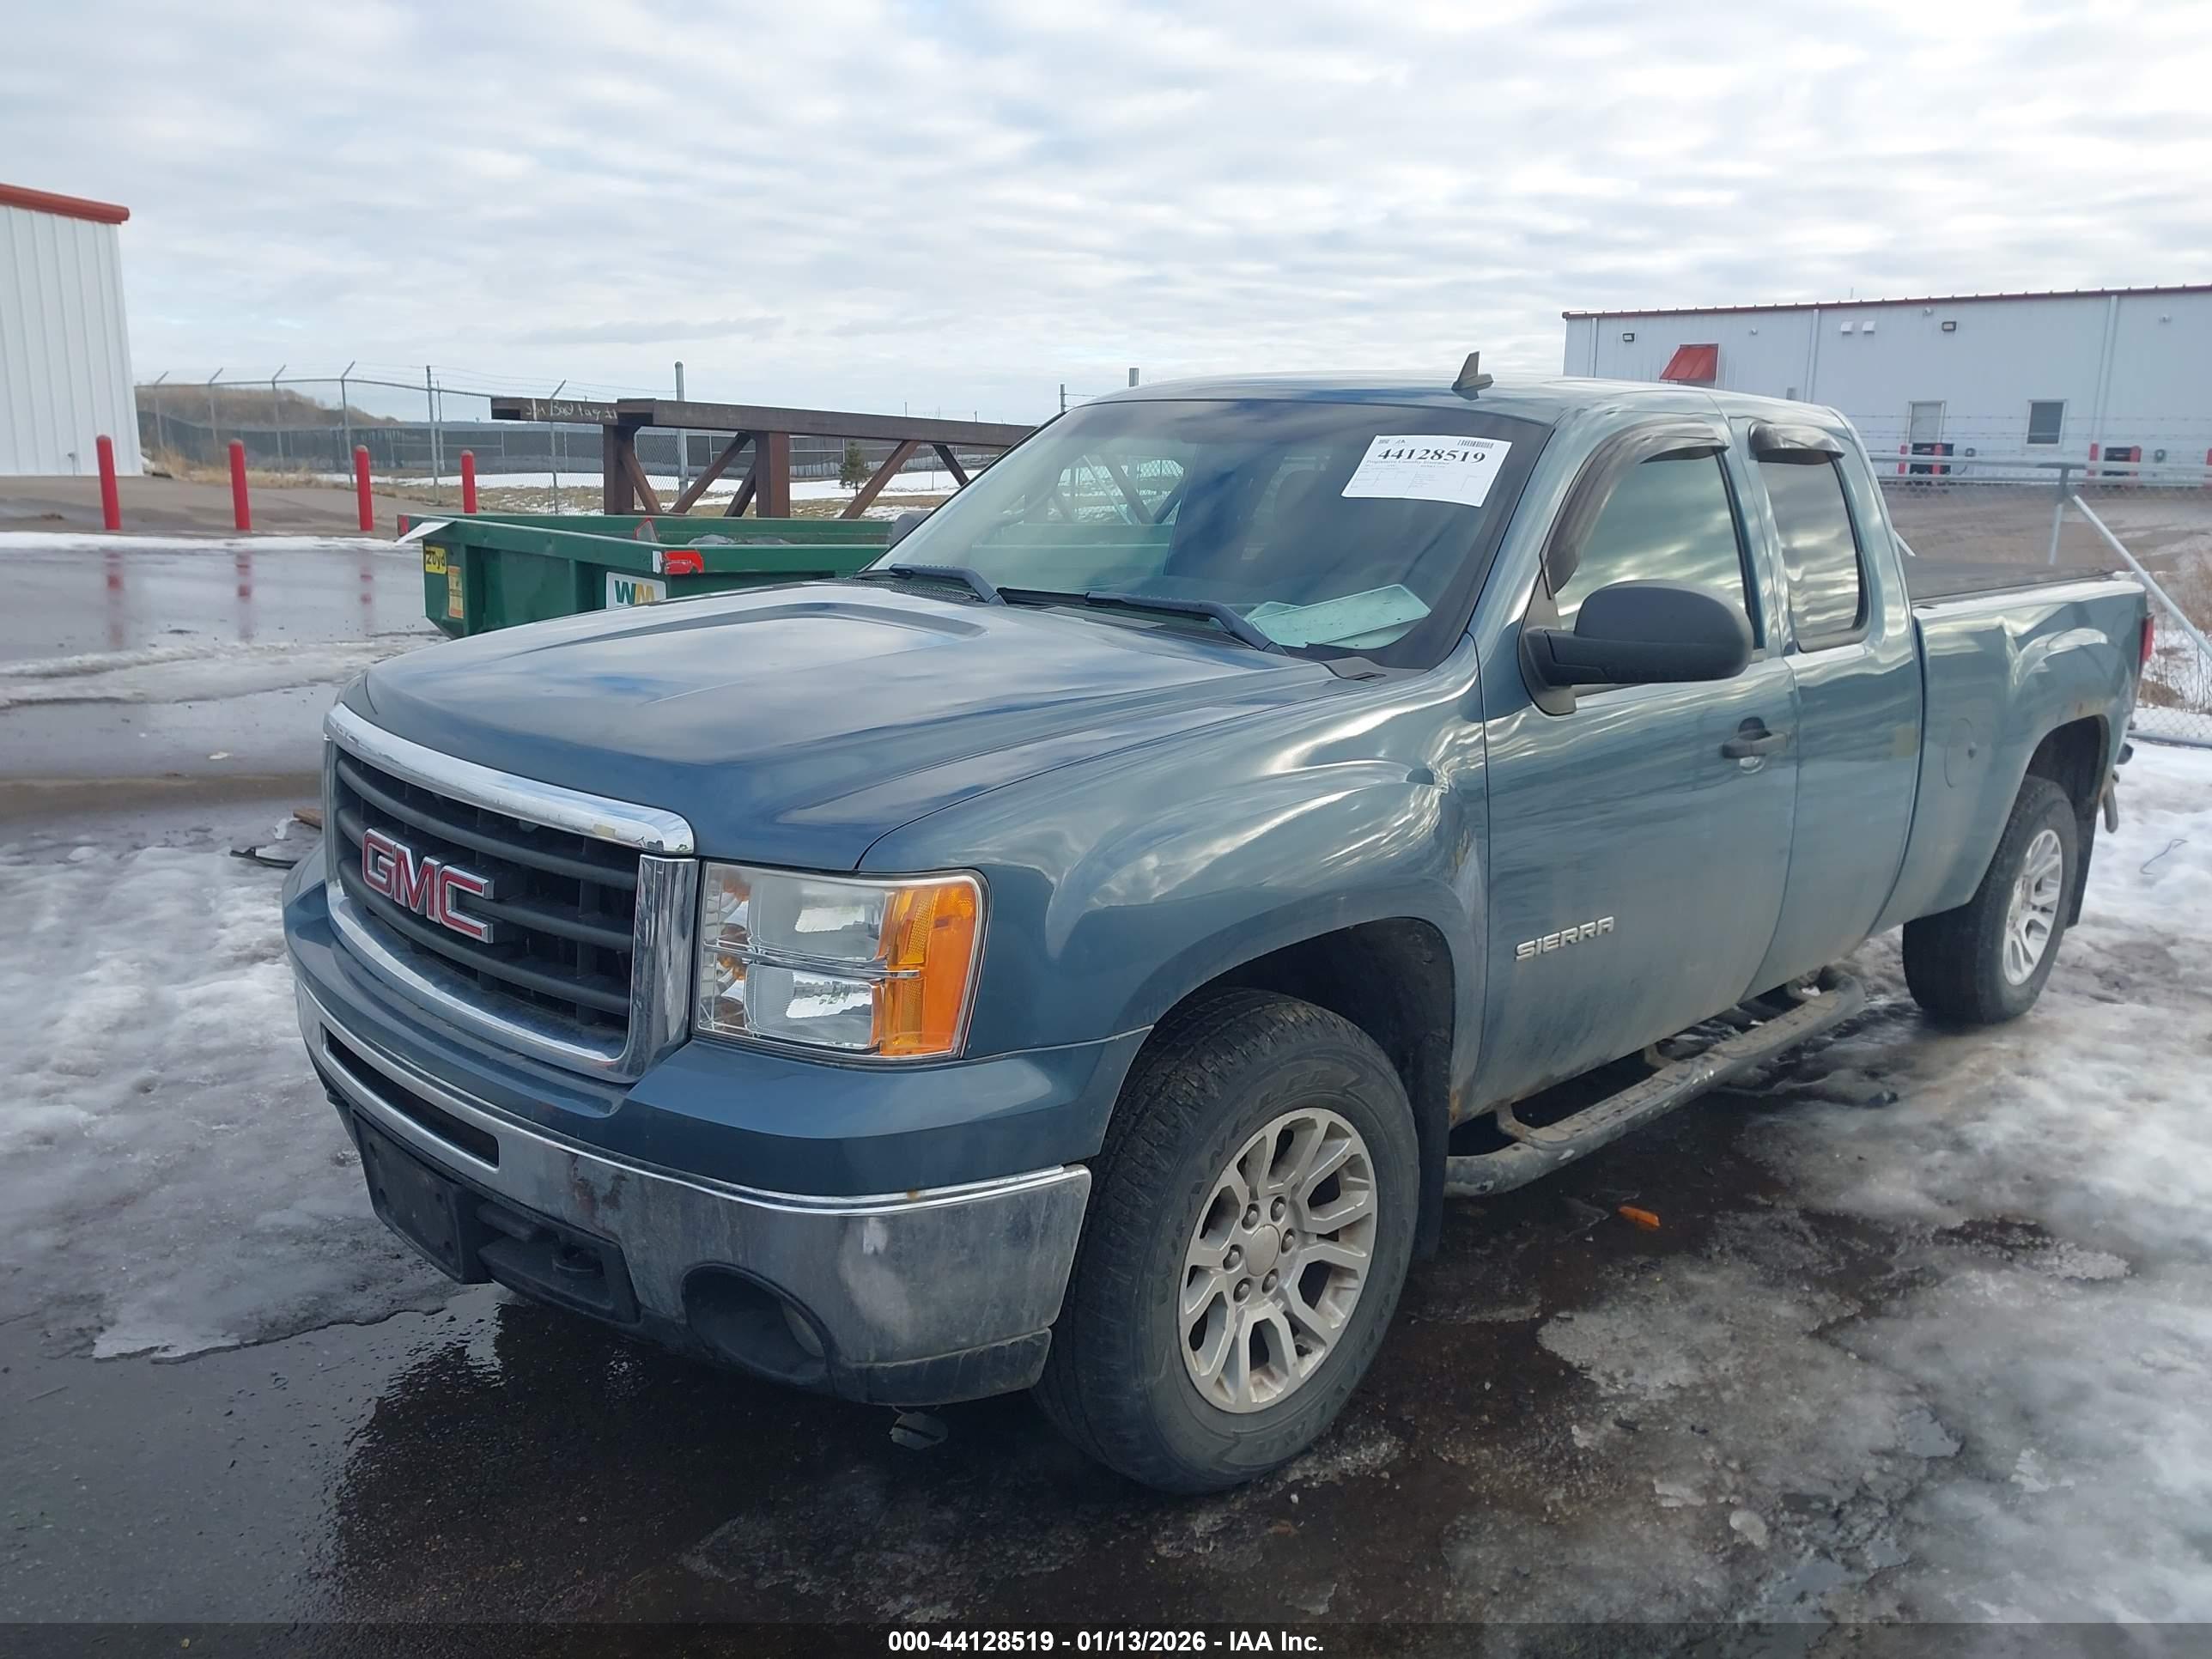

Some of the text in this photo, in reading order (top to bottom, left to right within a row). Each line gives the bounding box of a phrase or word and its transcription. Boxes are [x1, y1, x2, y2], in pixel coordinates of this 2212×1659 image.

[1377, 448, 1486, 465] 44128519
[615, 580, 654, 605] WM
[362, 828, 495, 944] GMC
[1515, 915, 1614, 961] SIERRA
